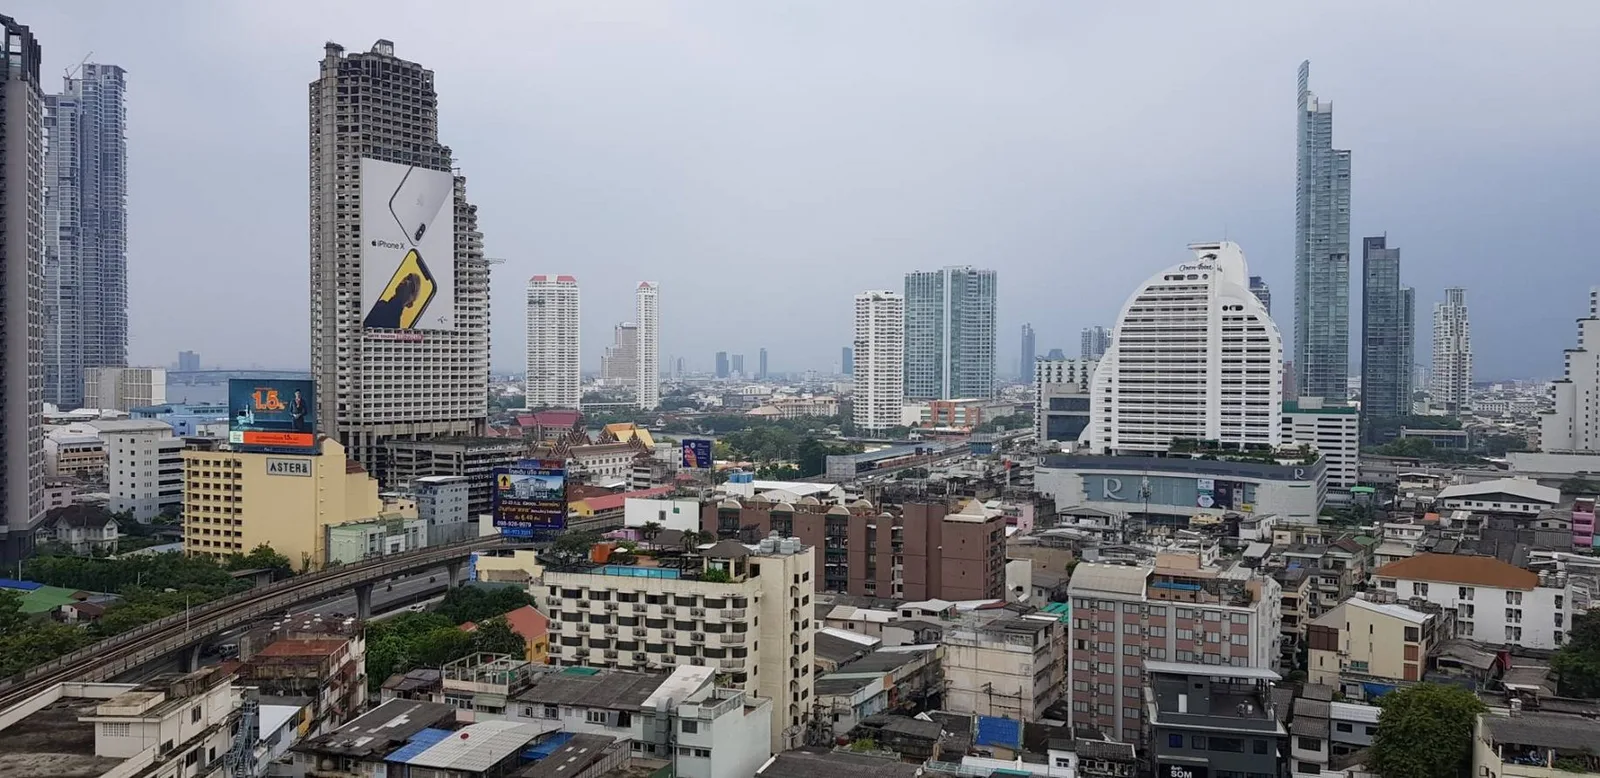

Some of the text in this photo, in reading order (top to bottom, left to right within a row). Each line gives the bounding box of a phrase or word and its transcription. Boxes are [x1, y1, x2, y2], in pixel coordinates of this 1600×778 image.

[377, 239, 405, 250] iPhone X
[1294, 468, 1304, 480] R
[1103, 478, 1127, 500] R
[1170, 770, 1192, 778] SOM
